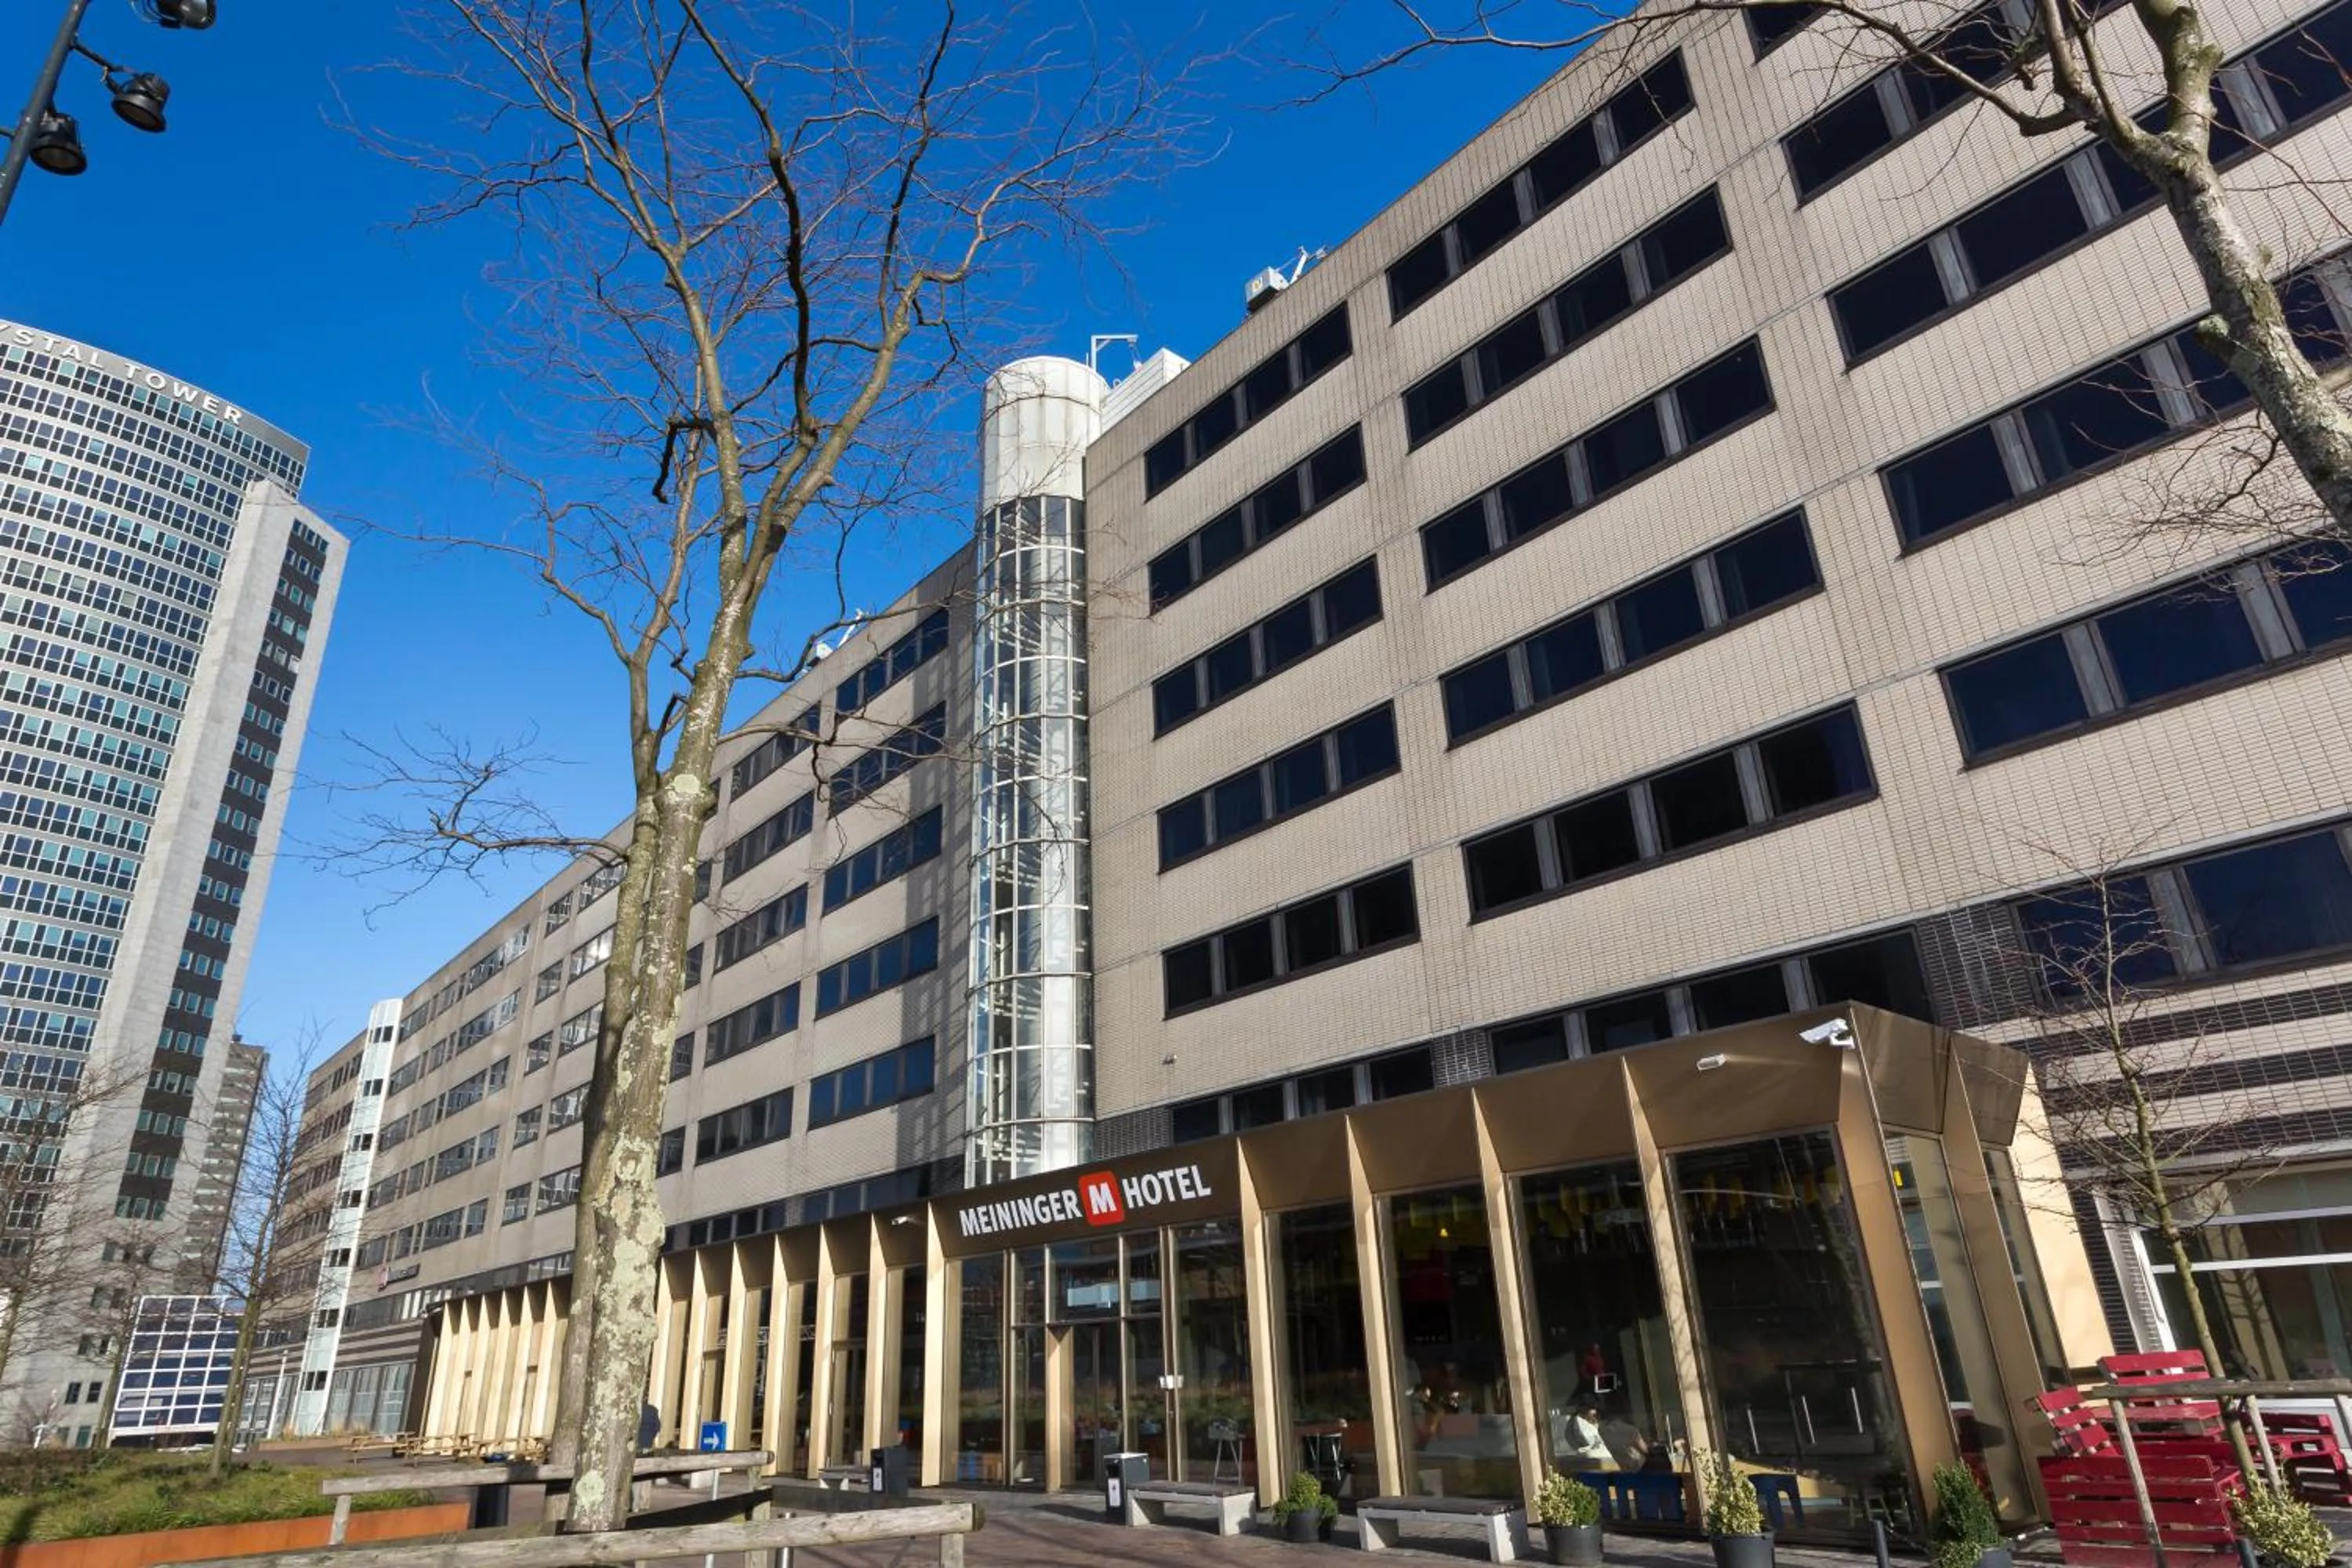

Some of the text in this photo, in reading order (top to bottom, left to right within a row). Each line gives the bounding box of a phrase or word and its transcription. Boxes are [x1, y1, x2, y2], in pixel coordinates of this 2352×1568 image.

[124, 362, 243, 425] TOWER
[959, 1164, 1211, 1236] MEININGER M HOTEL
